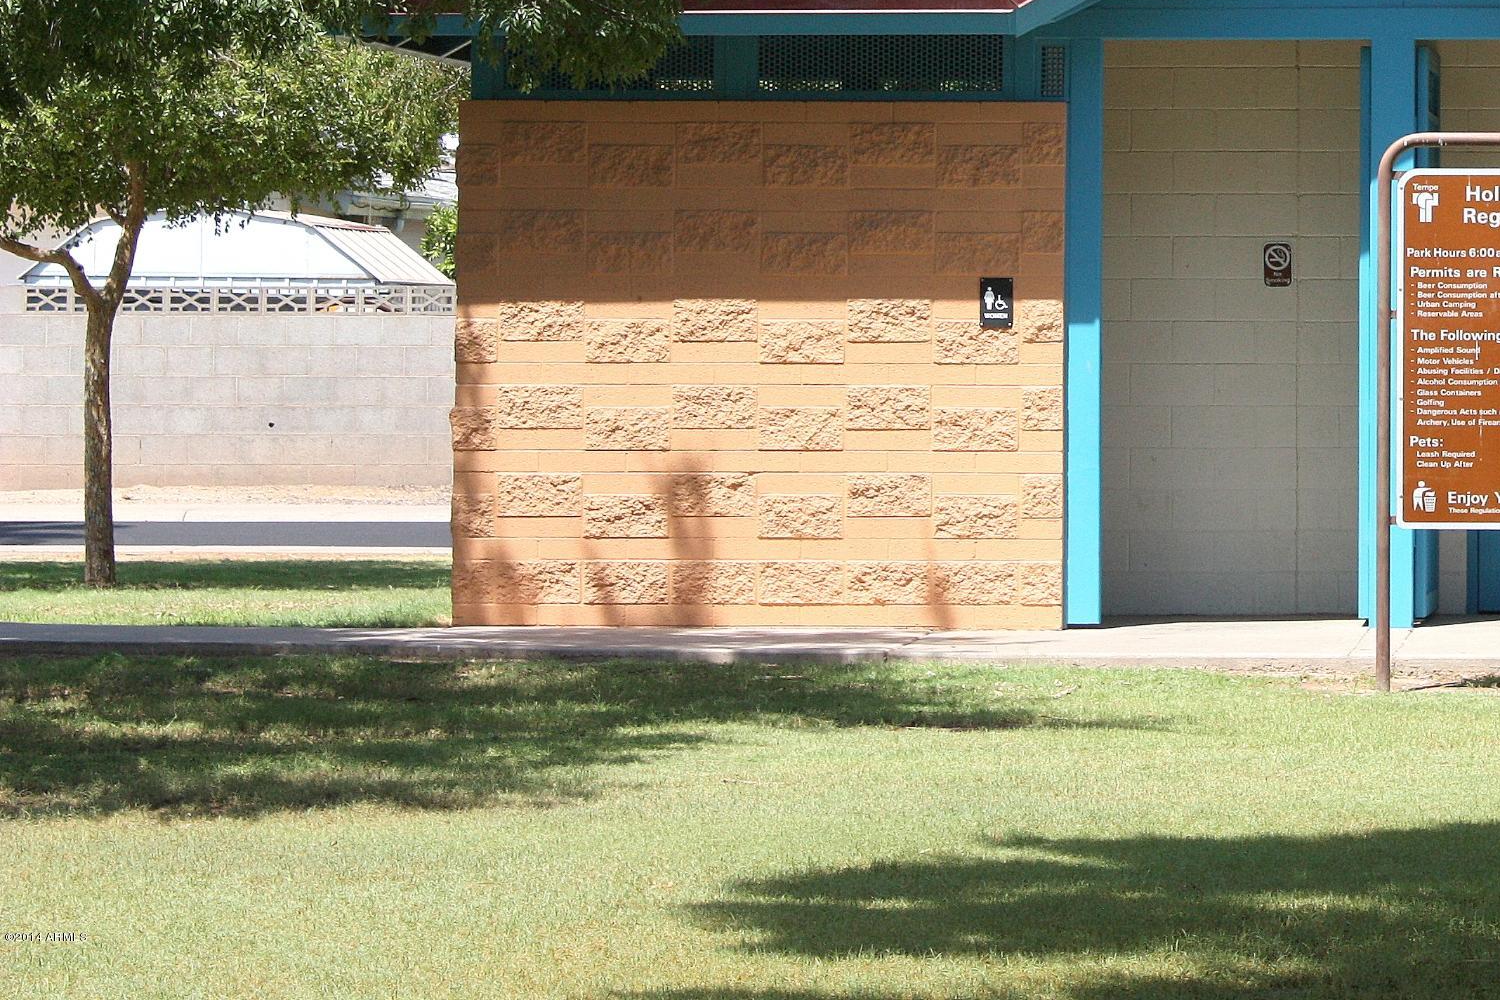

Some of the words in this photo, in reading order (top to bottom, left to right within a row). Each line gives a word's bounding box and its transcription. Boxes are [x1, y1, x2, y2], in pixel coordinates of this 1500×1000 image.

[1406, 248, 1433, 257] Park
[1433, 248, 1467, 259] Hours
[1410, 266, 1461, 277] Permits
[1466, 270, 1488, 278] are
[1417, 282, 1436, 290] Beer
[1437, 282, 1488, 290] Consumption
[1416, 291, 1436, 299] Beer
[1436, 291, 1488, 300] Consumption
[1441, 301, 1477, 310] Camping
[1416, 310, 1459, 318] Reservable
[1410, 329, 1437, 340] The
[1416, 347, 1455, 355] Amplified
[1455, 346, 1481, 355] Sound
[1416, 368, 1449, 376] Abusing
[1450, 367, 1485, 375] Facilities
[1416, 378, 1446, 386] Alcohol
[1447, 378, 1499, 387] Consumption
[1416, 389, 1439, 397] Glass
[1439, 389, 1482, 397] Containers
[1416, 399, 1445, 408] Golfing
[1416, 408, 1458, 417] Dangerous
[1416, 419, 1450, 427] Archery,
[1409, 436, 1444, 447] Pets:
[1441, 451, 1476, 459] Required
[1440, 461, 1452, 469] Up
[1447, 492, 1489, 506] Enjoy
